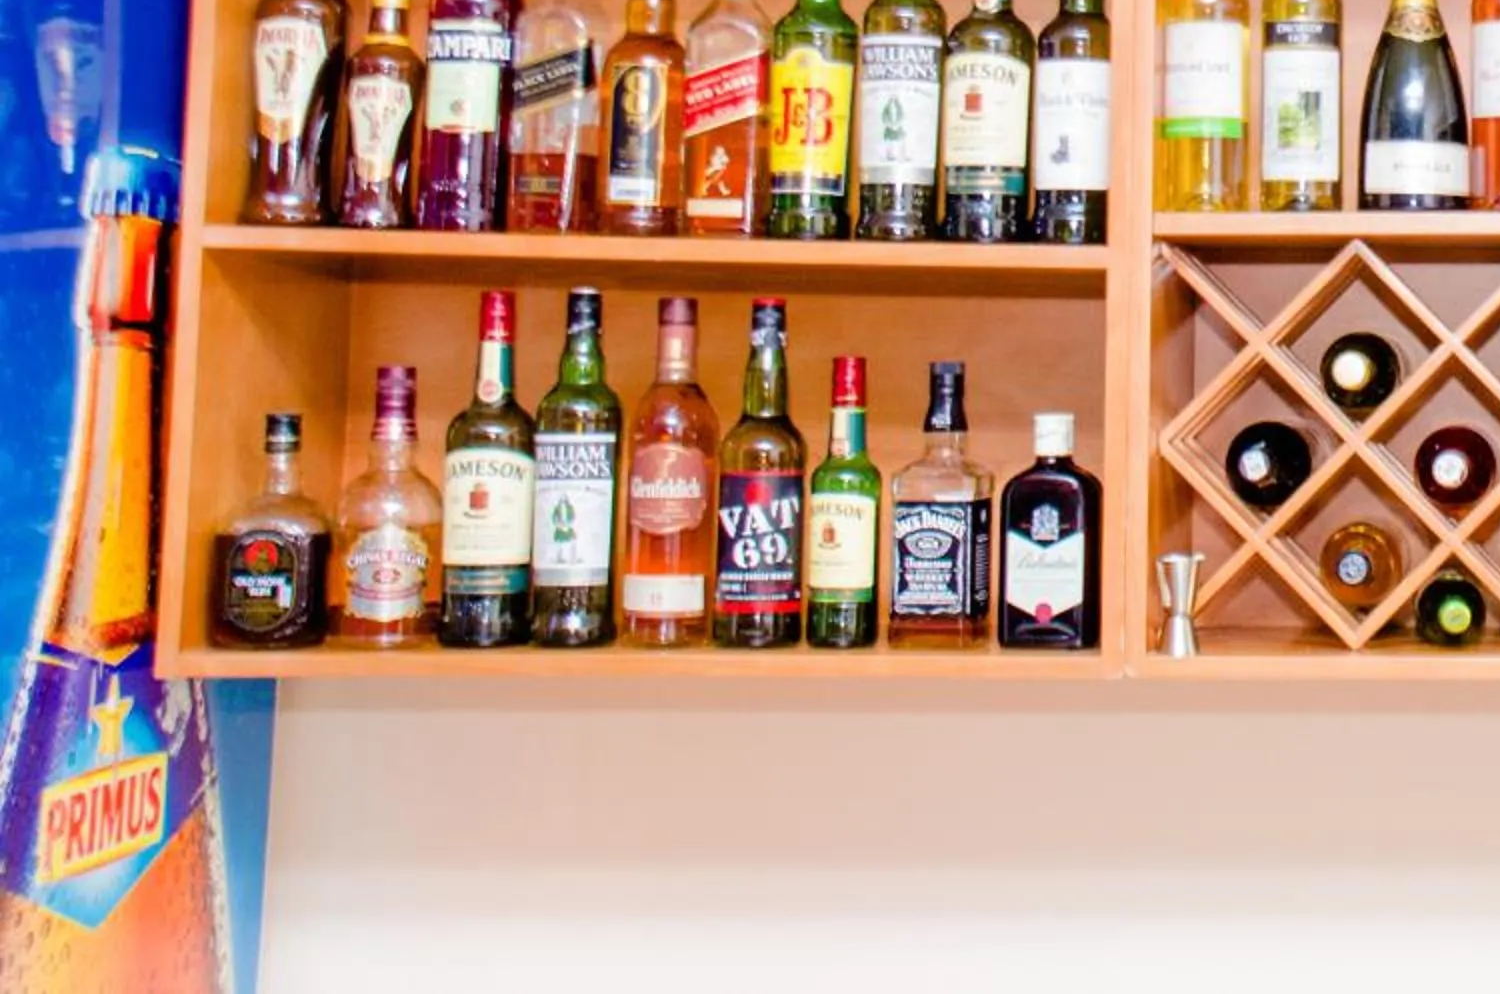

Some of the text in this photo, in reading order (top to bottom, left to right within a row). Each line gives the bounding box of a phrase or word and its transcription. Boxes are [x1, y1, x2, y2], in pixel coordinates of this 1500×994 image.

[861, 46, 936, 64] WILLIAM
[949, 62, 1019, 86] AMESON
[536, 445, 606, 461] WILLIAM
[451, 459, 525, 481] AMESON
[718, 496, 800, 540] VAT
[812, 502, 863, 520] MESON
[46, 766, 163, 864] PRIMUS
